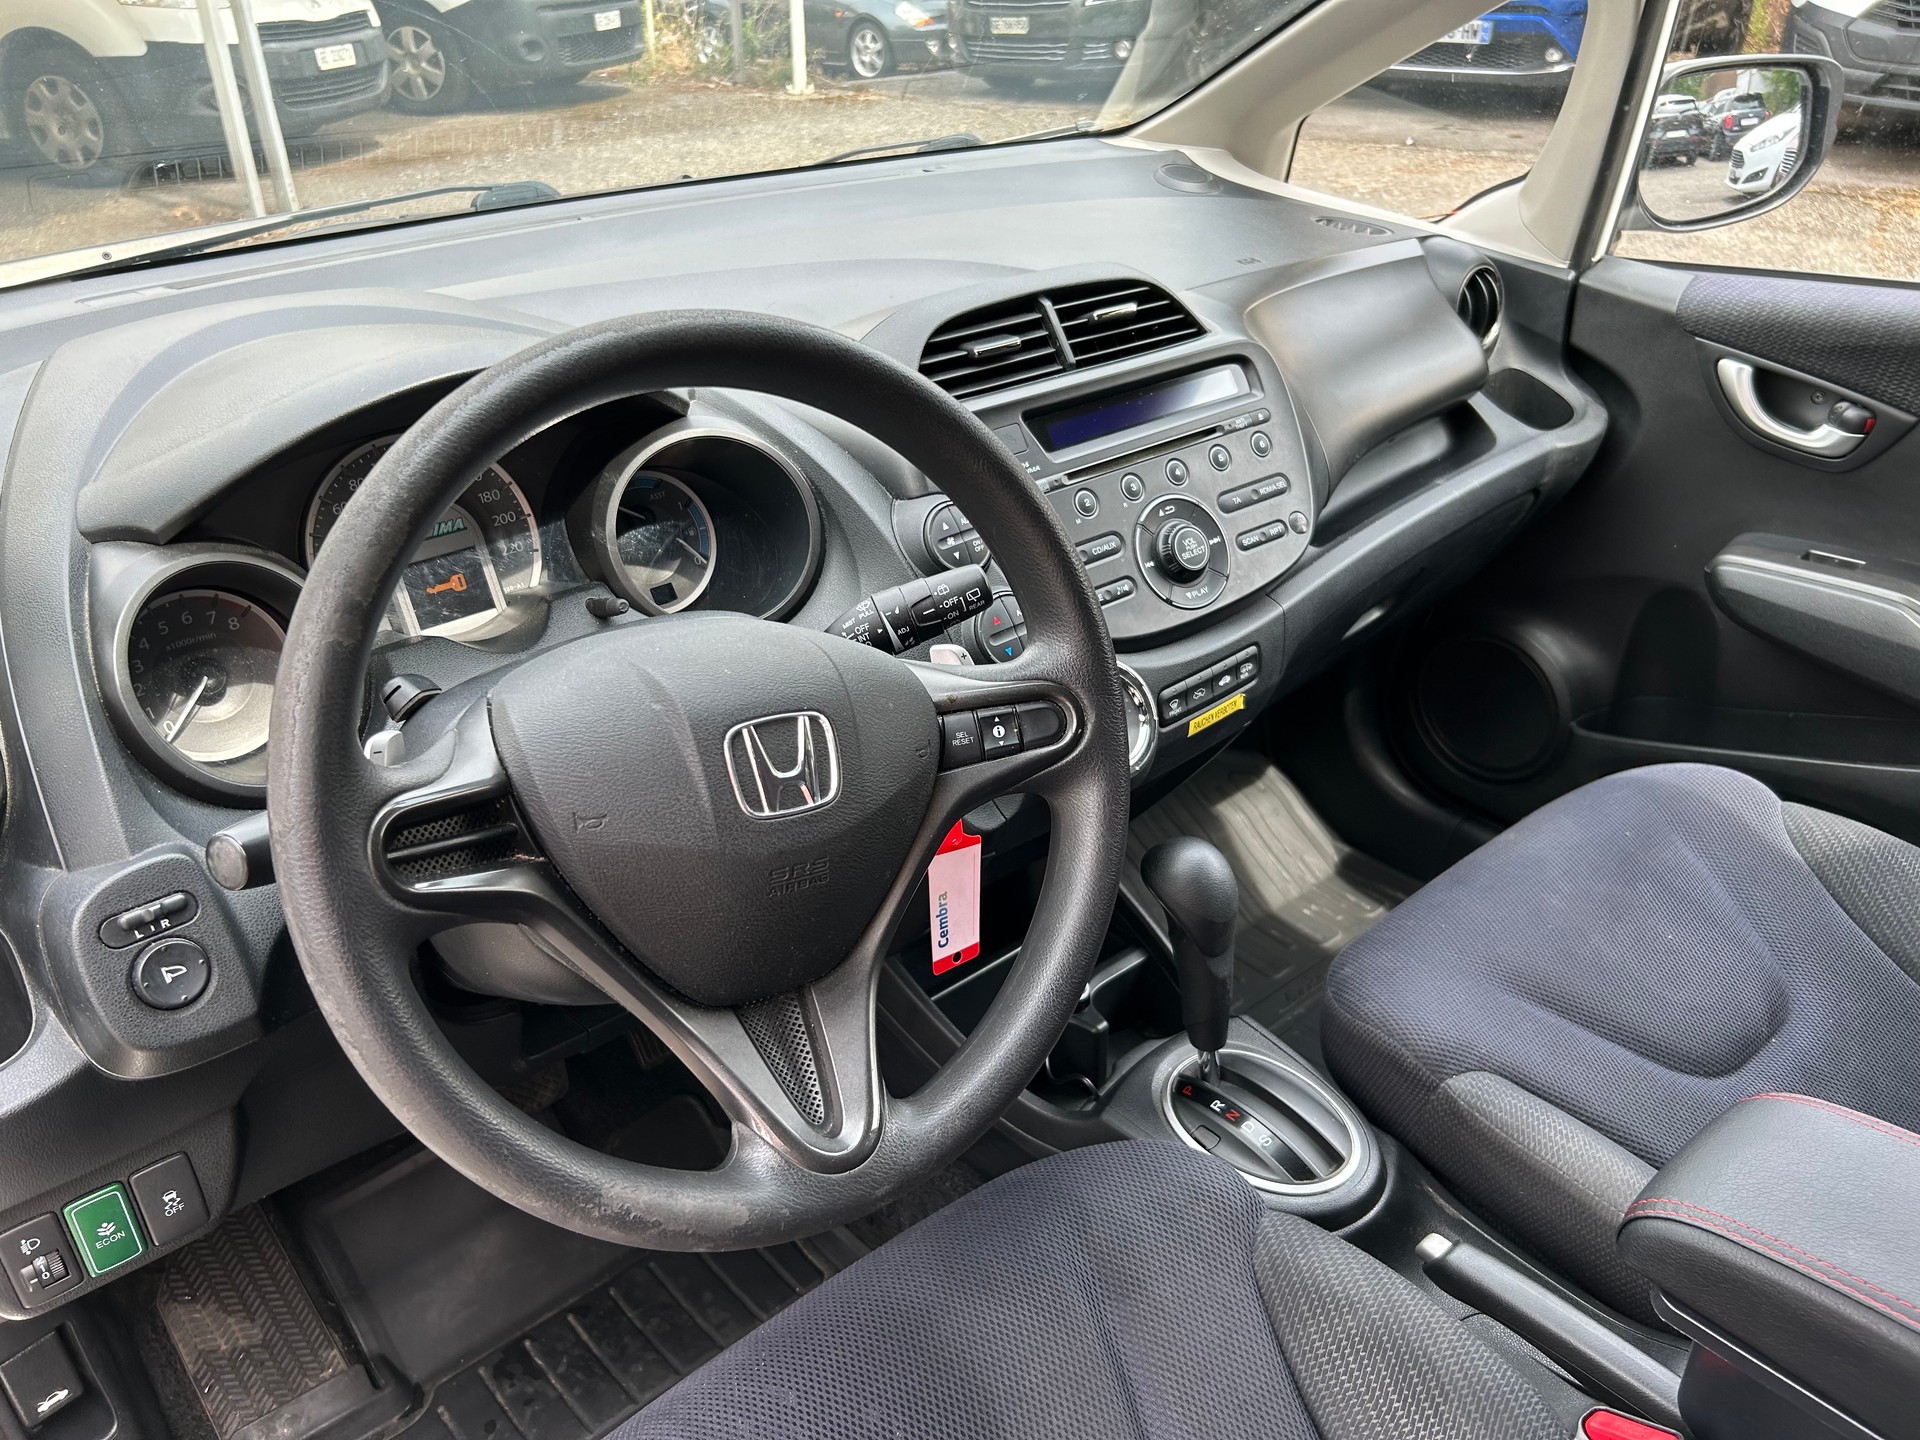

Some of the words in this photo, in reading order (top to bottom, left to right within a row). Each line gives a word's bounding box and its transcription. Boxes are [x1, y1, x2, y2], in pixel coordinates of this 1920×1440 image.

[1259, 440, 1266, 448] 6
[1217, 453, 1224, 462] 5
[1174, 468, 1181, 476] 4
[1130, 483, 1137, 491] 3
[478, 489, 501, 504] 180
[1083, 498, 1091, 507] 2
[491, 511, 517, 527] 200
[1182, 537, 1197, 546] VOL
[1242, 535, 1259, 546] SCAN
[1269, 525, 1283, 536] RPT
[974, 544, 985, 553] OFF
[1091, 541, 1117, 555] CD/AUX
[1181, 545, 1206, 560] SELECT
[1191, 586, 1209, 598] PLAY
[942, 596, 959, 609] OFF
[968, 600, 986, 611] REAR
[858, 609, 875, 620] PULL
[947, 610, 960, 620] ON
[157, 621, 169, 636] 5
[181, 611, 193, 625] 6
[205, 610, 217, 625] 7
[228, 617, 240, 631] 8
[854, 622, 870, 635] OFF
[897, 626, 910, 636] ADJ
[133, 683, 146, 697] 2
[952, 736, 974, 746] RESET
[955, 731, 968, 739] SEL
[936, 891, 949, 949] Cembra
[134, 929, 144, 939] L
[160, 918, 171, 929] R
[1182, 1085, 1193, 1096] P
[1210, 1099, 1226, 1112] R
[1225, 1108, 1241, 1122] N
[1240, 1121, 1255, 1135] D
[1258, 1134, 1272, 1147] S
[165, 1203, 185, 1217] OFF
[96, 1230, 125, 1249] ECON
[41, 1271, 50, 1280] 0
